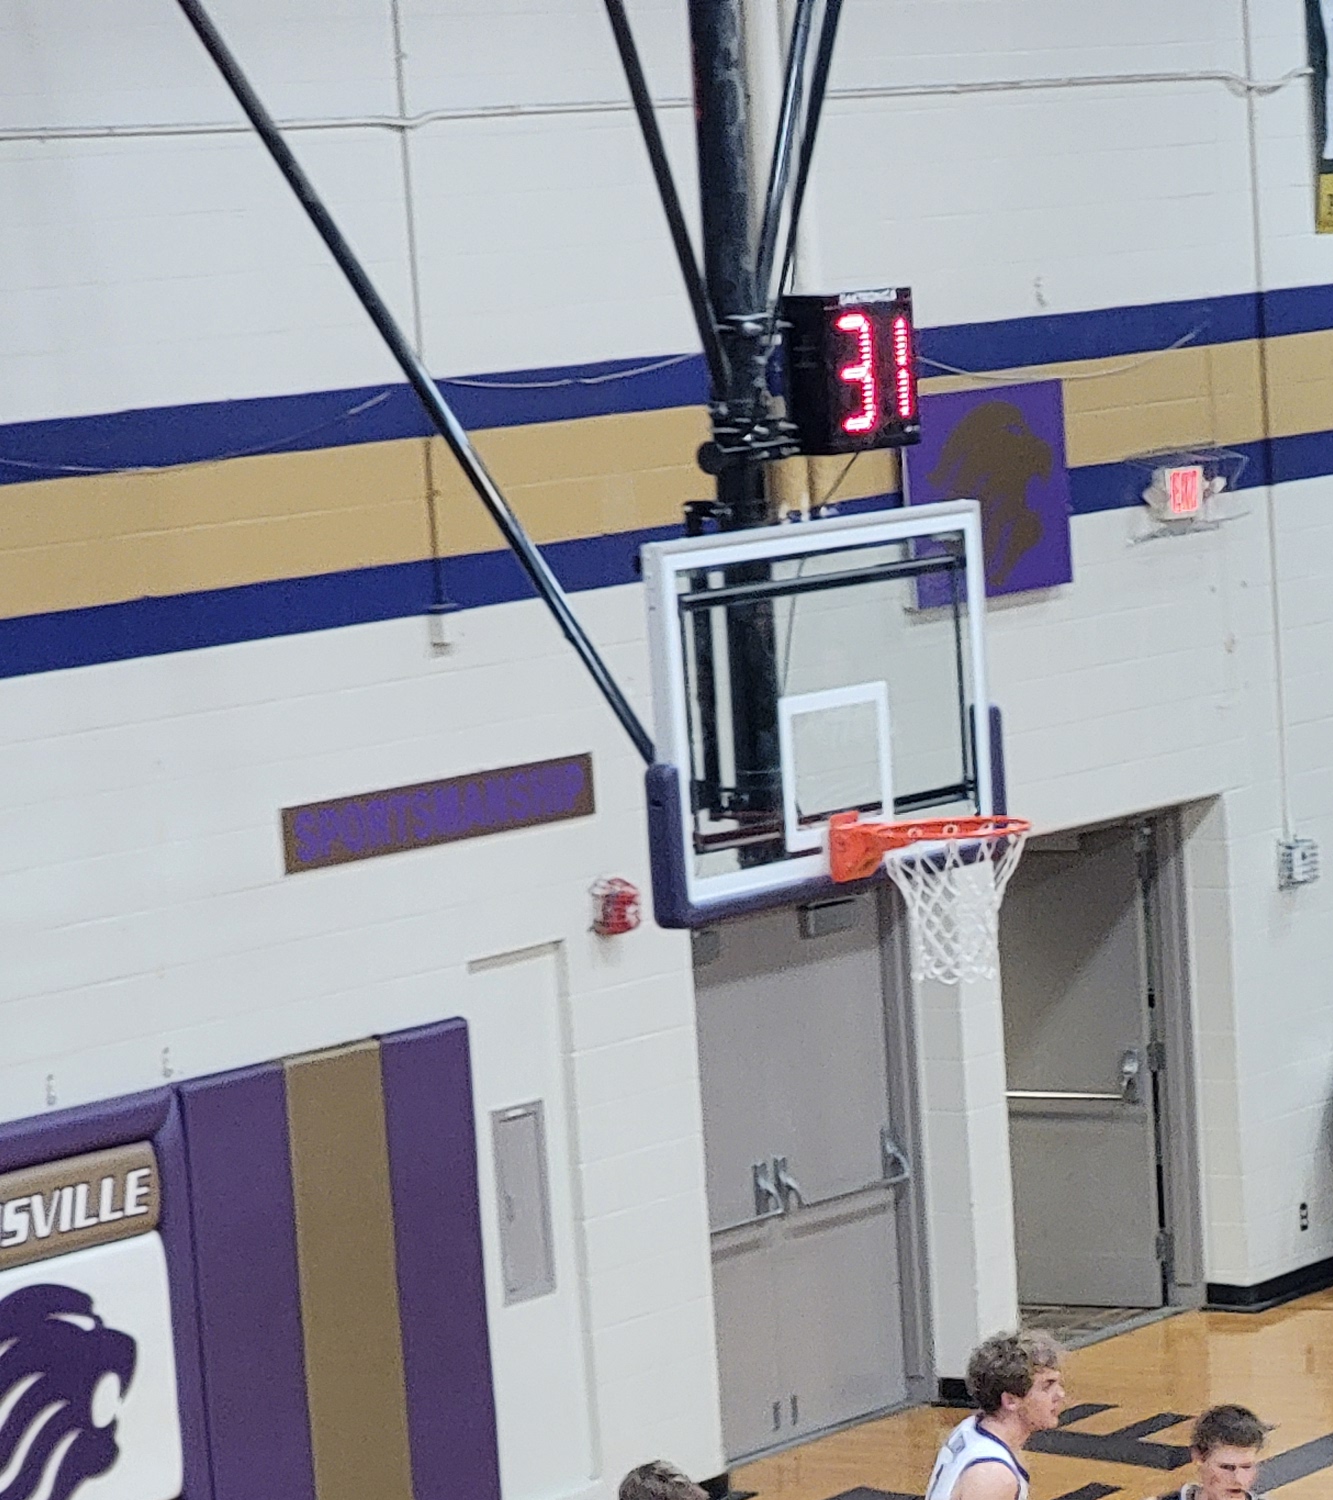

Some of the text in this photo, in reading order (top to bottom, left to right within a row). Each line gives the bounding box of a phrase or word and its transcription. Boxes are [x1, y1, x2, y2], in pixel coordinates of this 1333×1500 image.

[836, 313, 912, 433] 31
[293, 763, 586, 863] SPORTSMANSHIP
[0, 1167, 152, 1248] SVILLE
